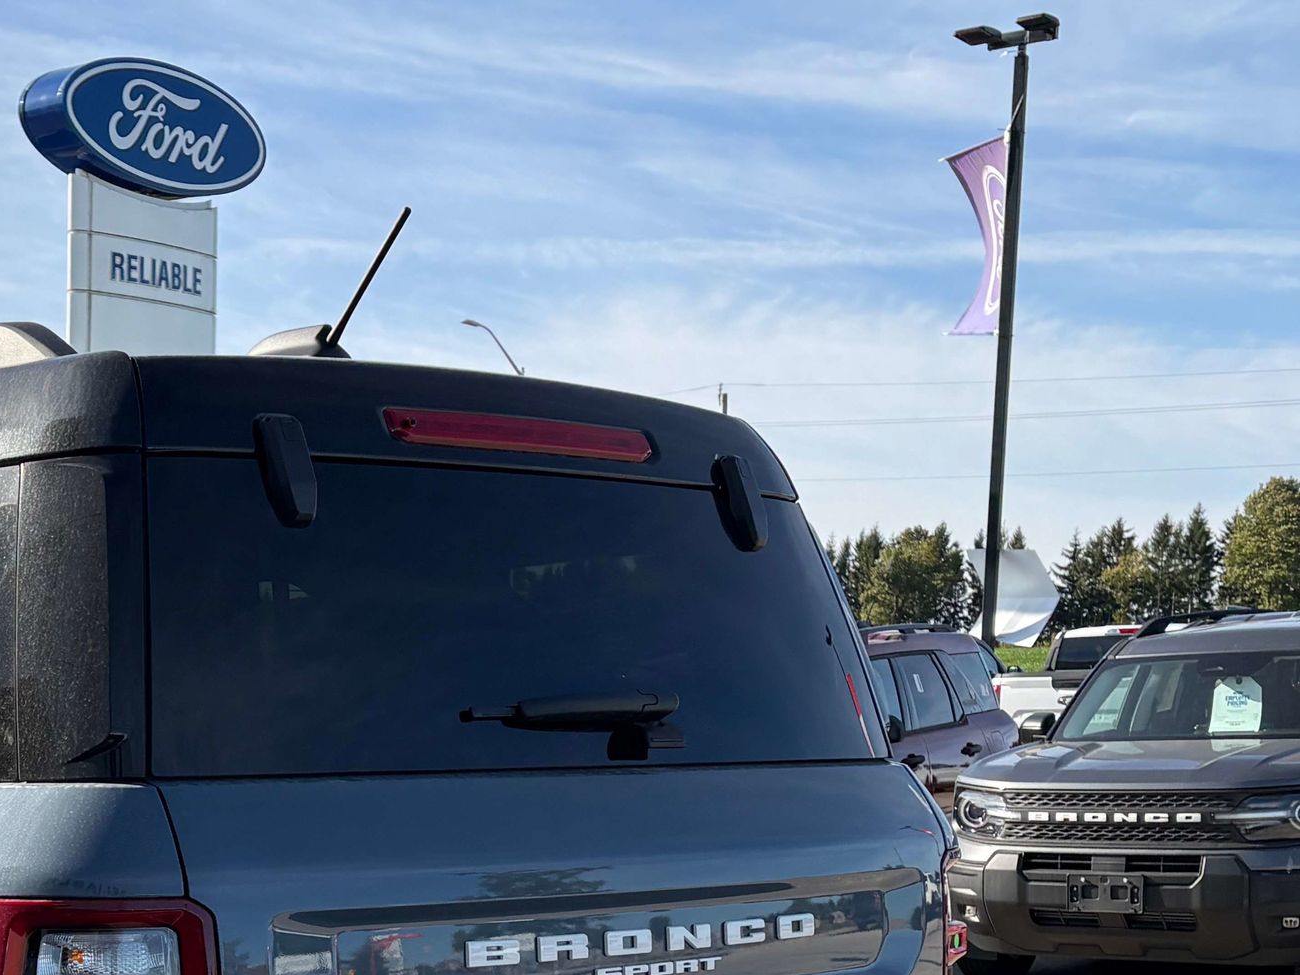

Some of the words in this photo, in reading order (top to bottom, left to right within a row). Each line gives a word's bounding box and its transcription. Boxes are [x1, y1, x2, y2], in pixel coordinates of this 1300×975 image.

[108, 78, 229, 174] Ford
[110, 251, 202, 296] RELIABLE
[1028, 812, 1201, 823] BRONCO
[465, 912, 815, 968] BRONCO
